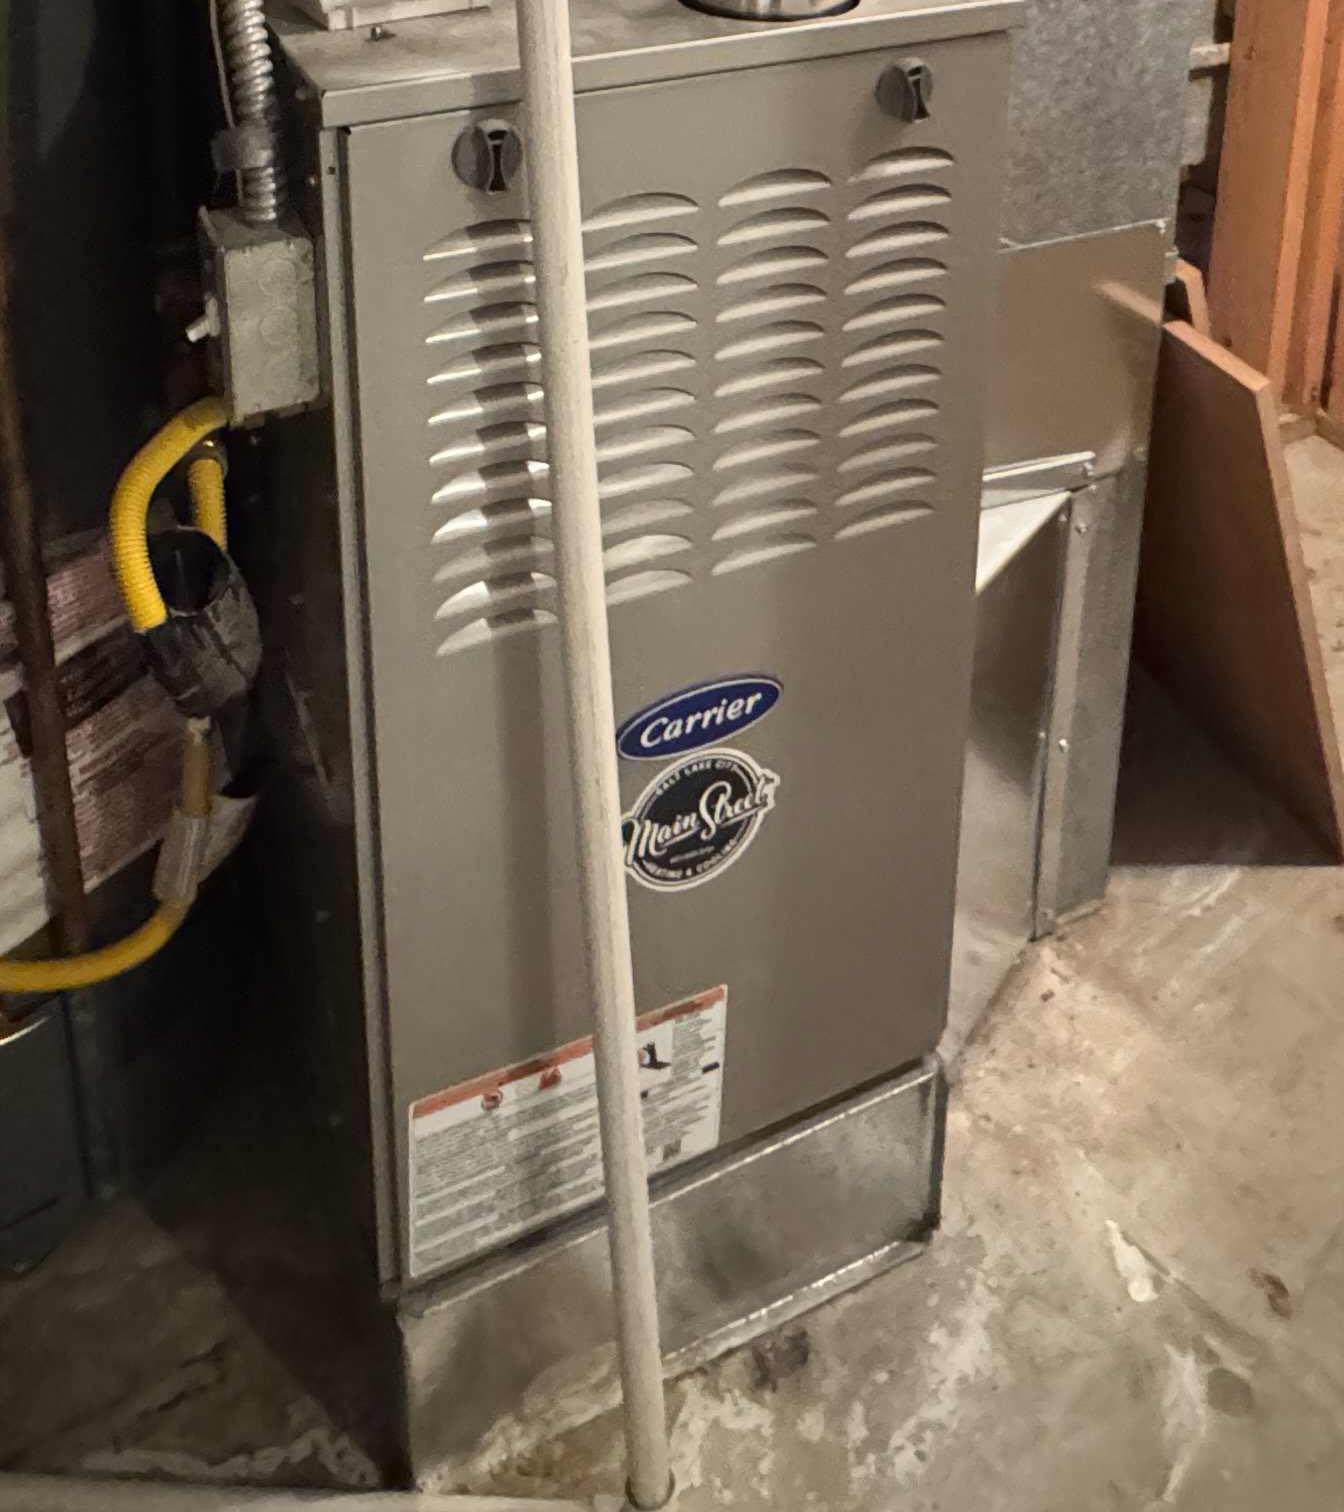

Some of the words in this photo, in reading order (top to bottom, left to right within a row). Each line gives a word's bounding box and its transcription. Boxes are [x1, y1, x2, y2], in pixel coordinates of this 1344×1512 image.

[640, 692, 762, 748] Carrier
[655, 771, 681, 796] SALT
[683, 759, 713, 777] LAKE
[624, 812, 698, 864] Main
[699, 776, 770, 839] Street
